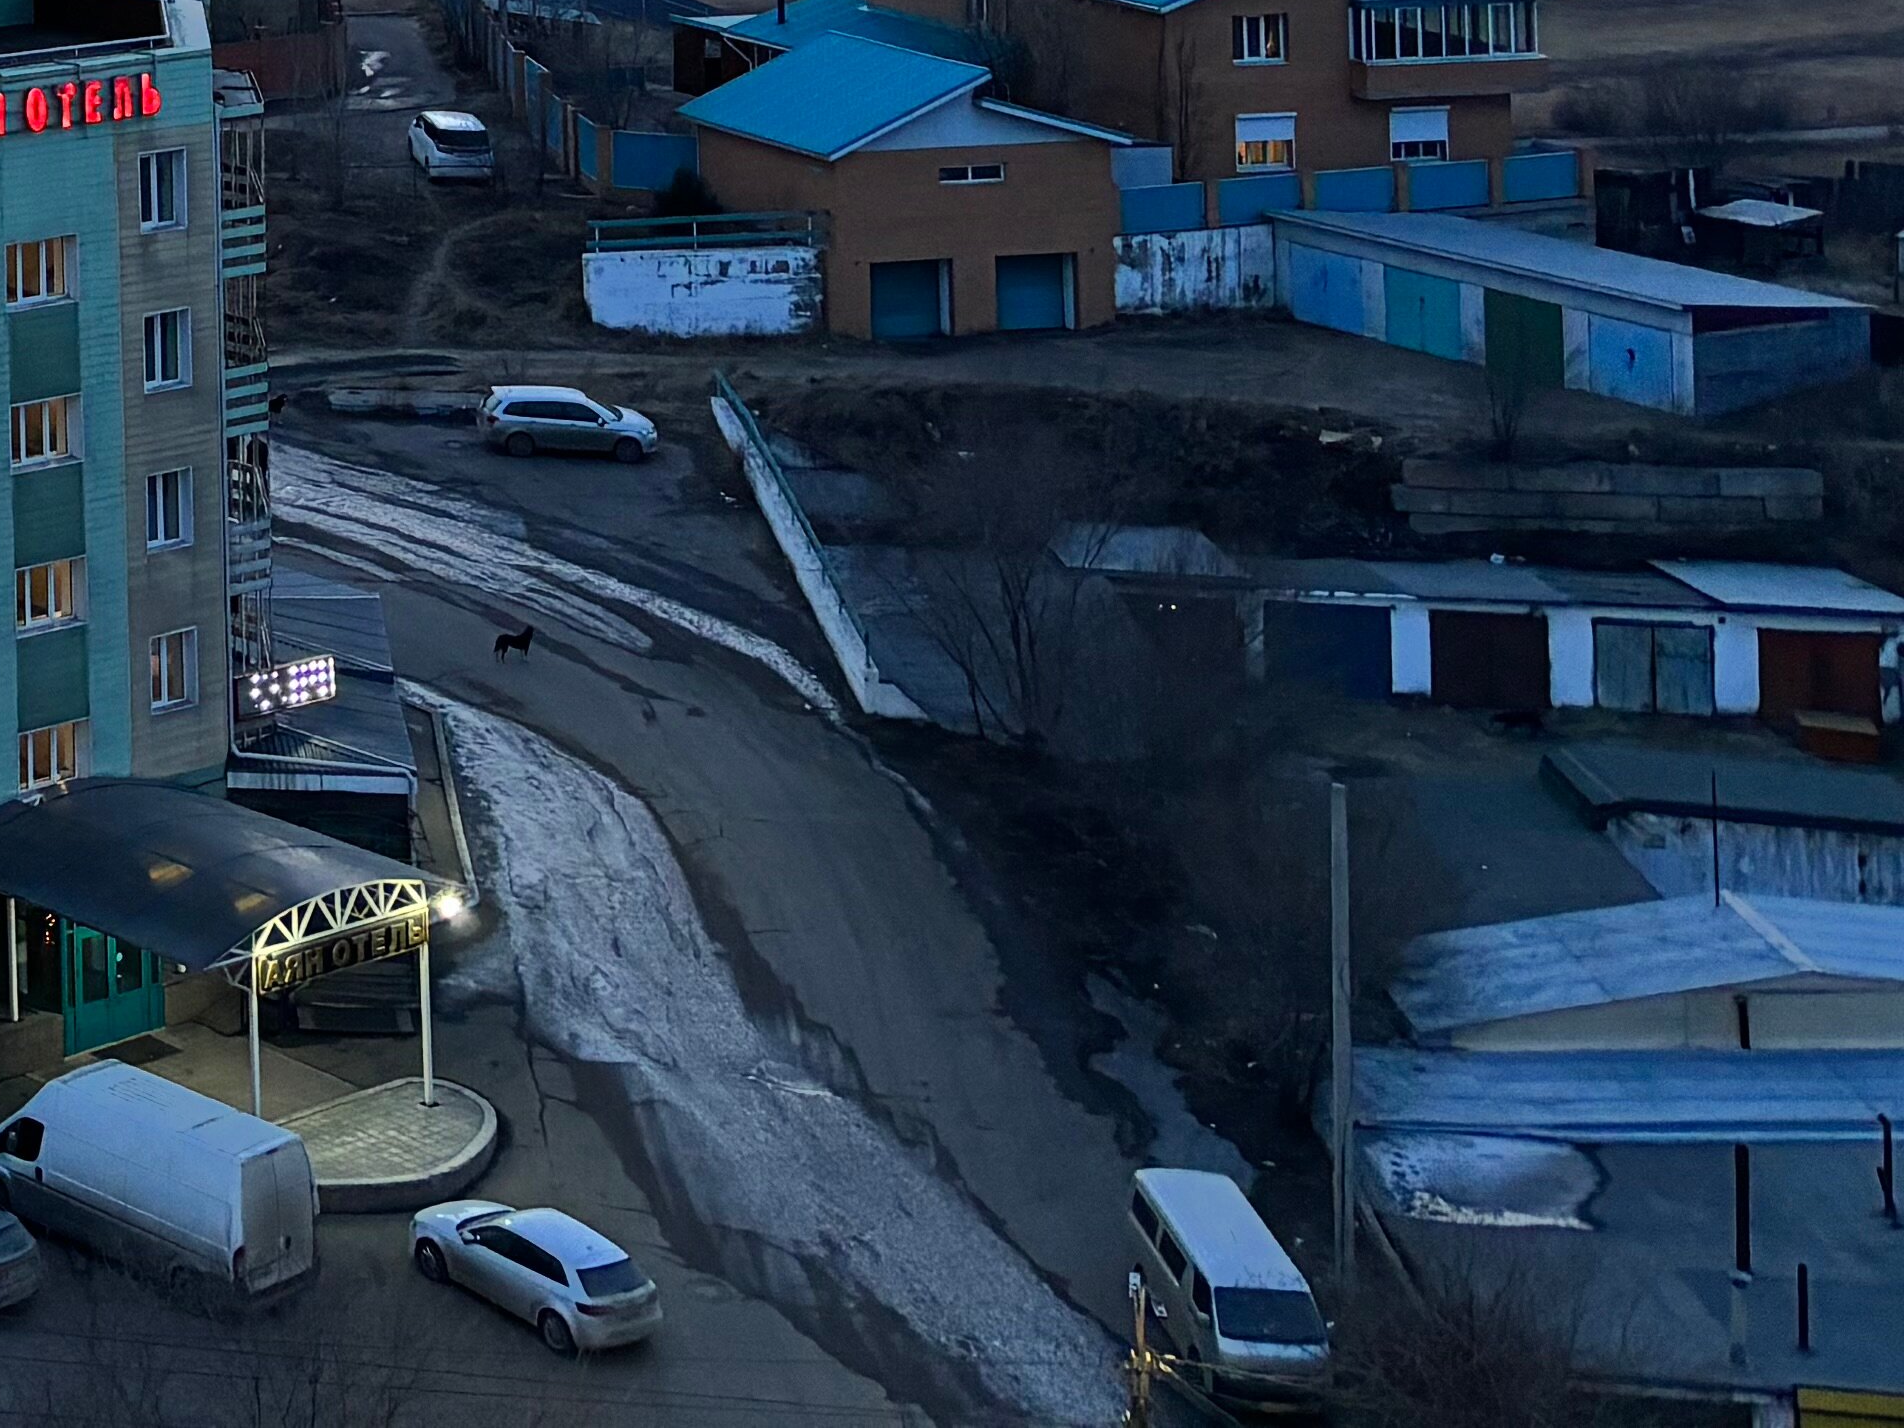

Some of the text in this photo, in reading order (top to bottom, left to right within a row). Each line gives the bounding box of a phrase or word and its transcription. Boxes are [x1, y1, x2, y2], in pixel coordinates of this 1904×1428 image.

[24, 72, 163, 134] ОТЕЛЬ
[263, 918, 423, 990] АЯН ОТЕЛЬ
